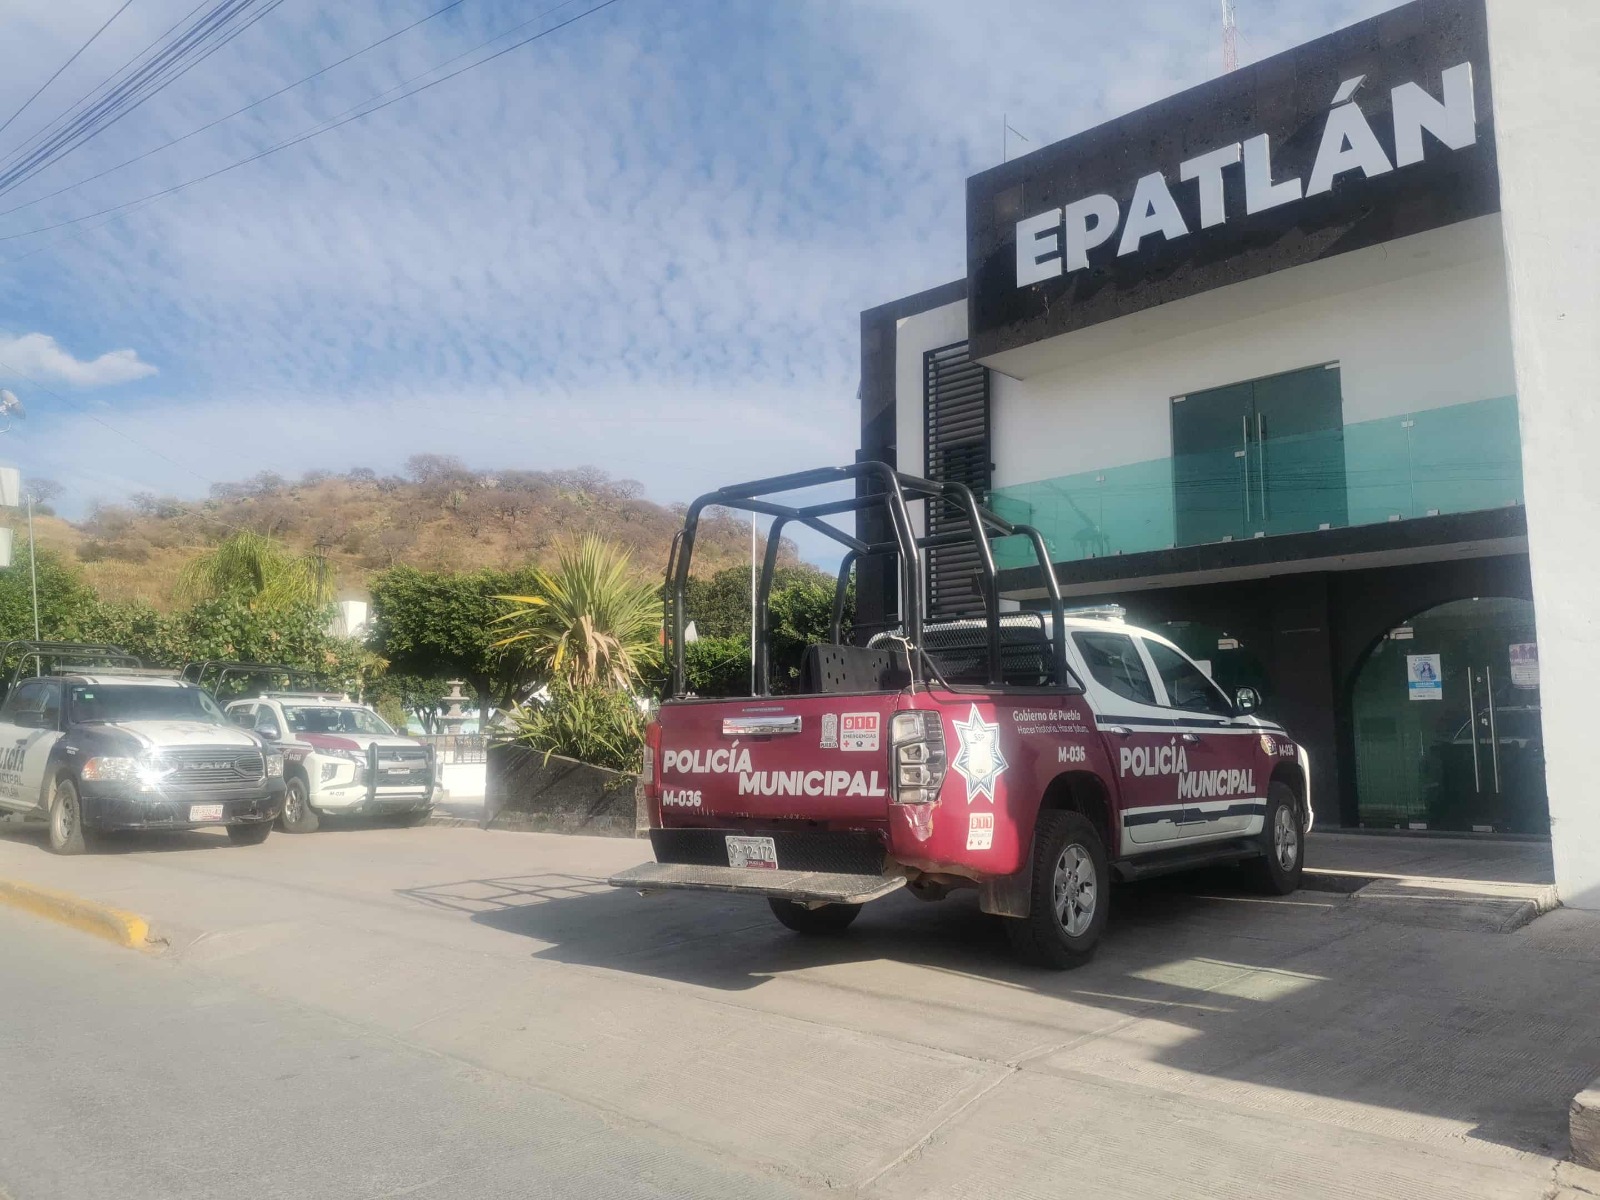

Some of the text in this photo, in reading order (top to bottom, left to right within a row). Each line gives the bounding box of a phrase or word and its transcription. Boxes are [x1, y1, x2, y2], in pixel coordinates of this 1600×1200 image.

[1016, 61, 1477, 288] EPATLÁN
[845, 716, 875, 729] 911
[1012, 708, 1081, 721] Gobierno de Puebla
[662, 739, 753, 774] POLICÍA
[1058, 745, 1086, 763] M-036
[1120, 737, 1188, 778] POLICÍA
[738, 770, 886, 797] MUNICIPAL
[1177, 768, 1256, 799] MUNICIPAL
[662, 790, 703, 807] M-036
[971, 816, 993, 829] 911
